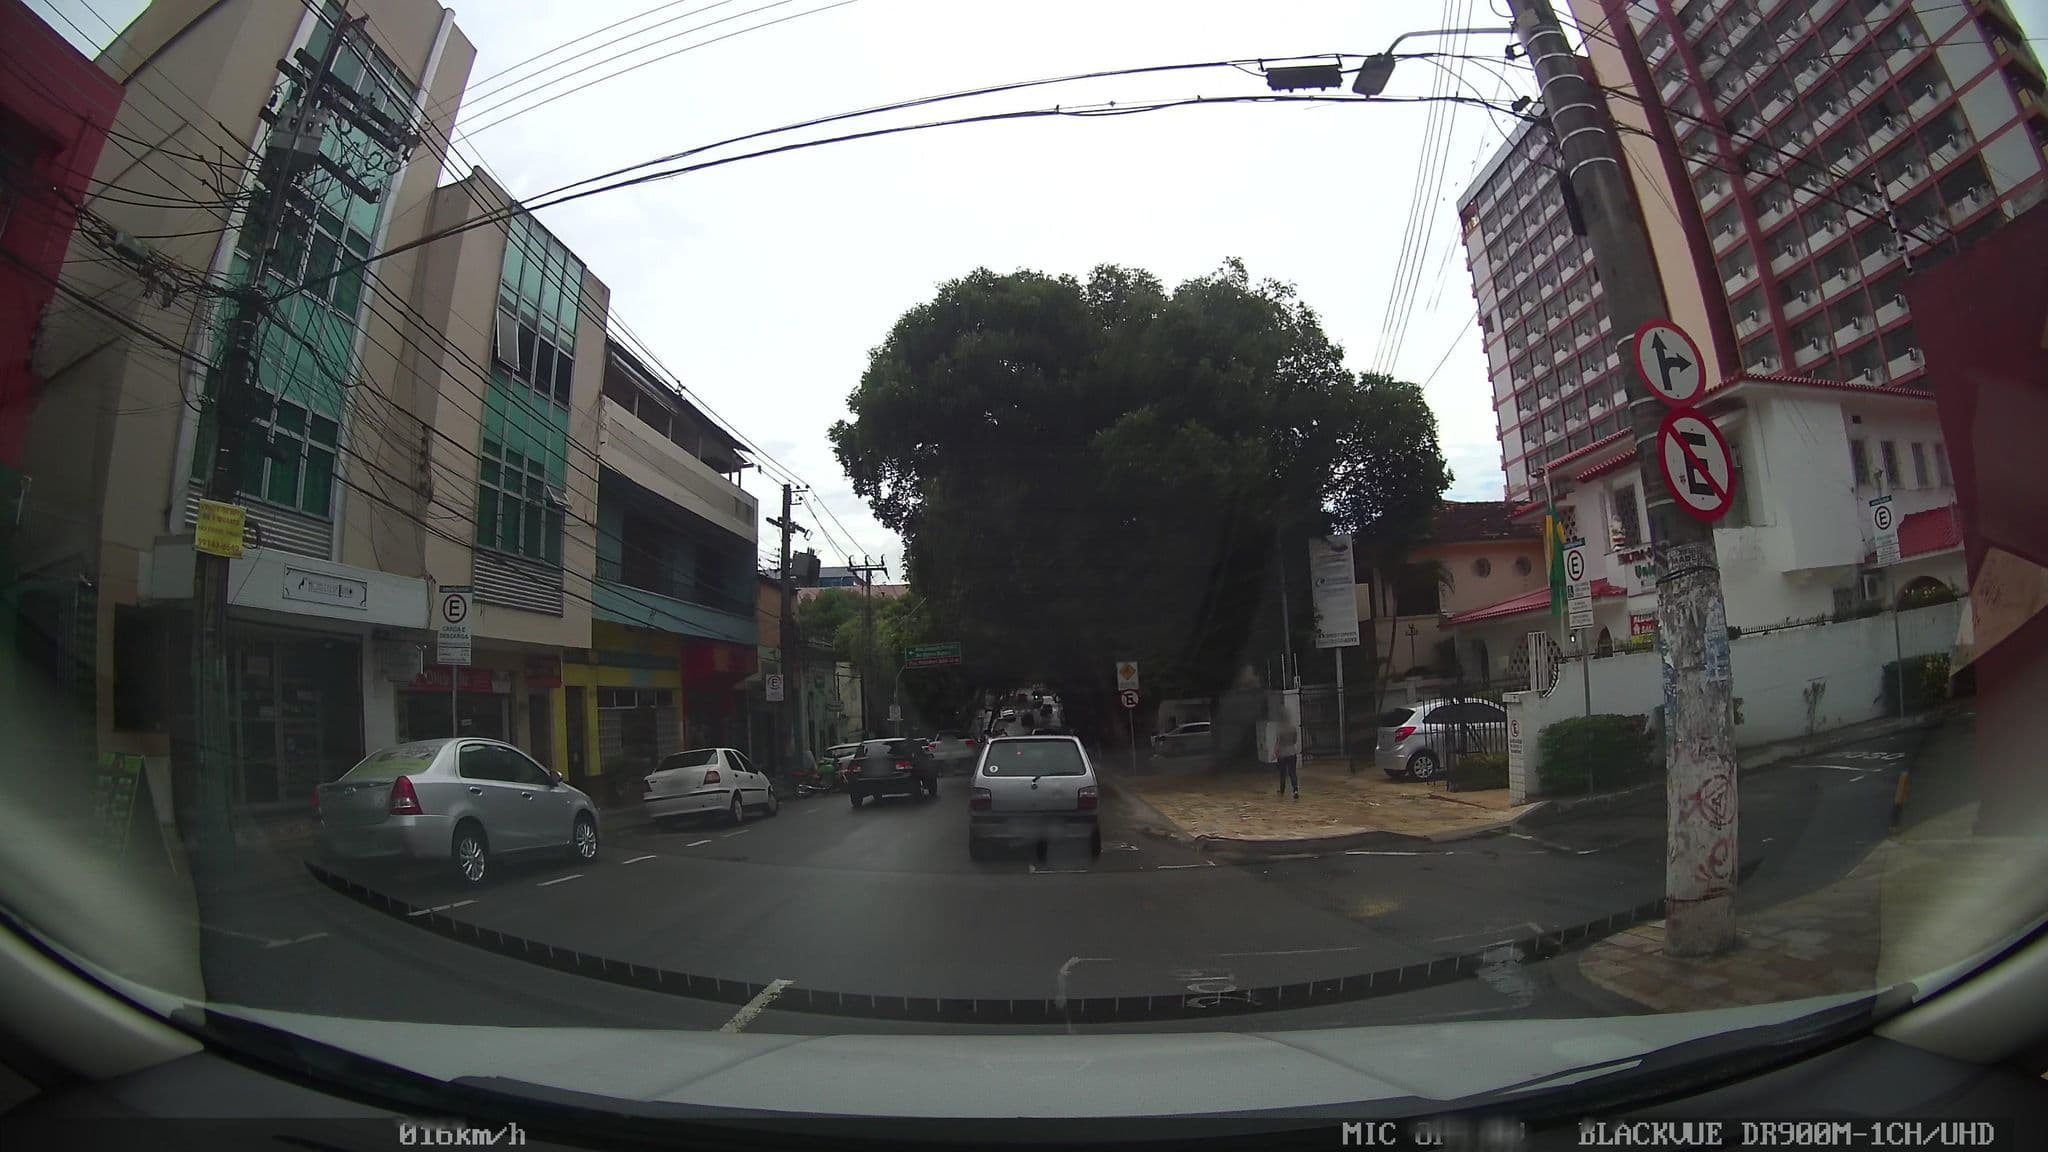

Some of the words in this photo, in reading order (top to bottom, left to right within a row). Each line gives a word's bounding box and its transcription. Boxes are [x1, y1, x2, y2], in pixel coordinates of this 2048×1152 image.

[1879, 511, 1887, 525] E
[1571, 556, 1580, 574] E
[449, 600, 460, 616] E
